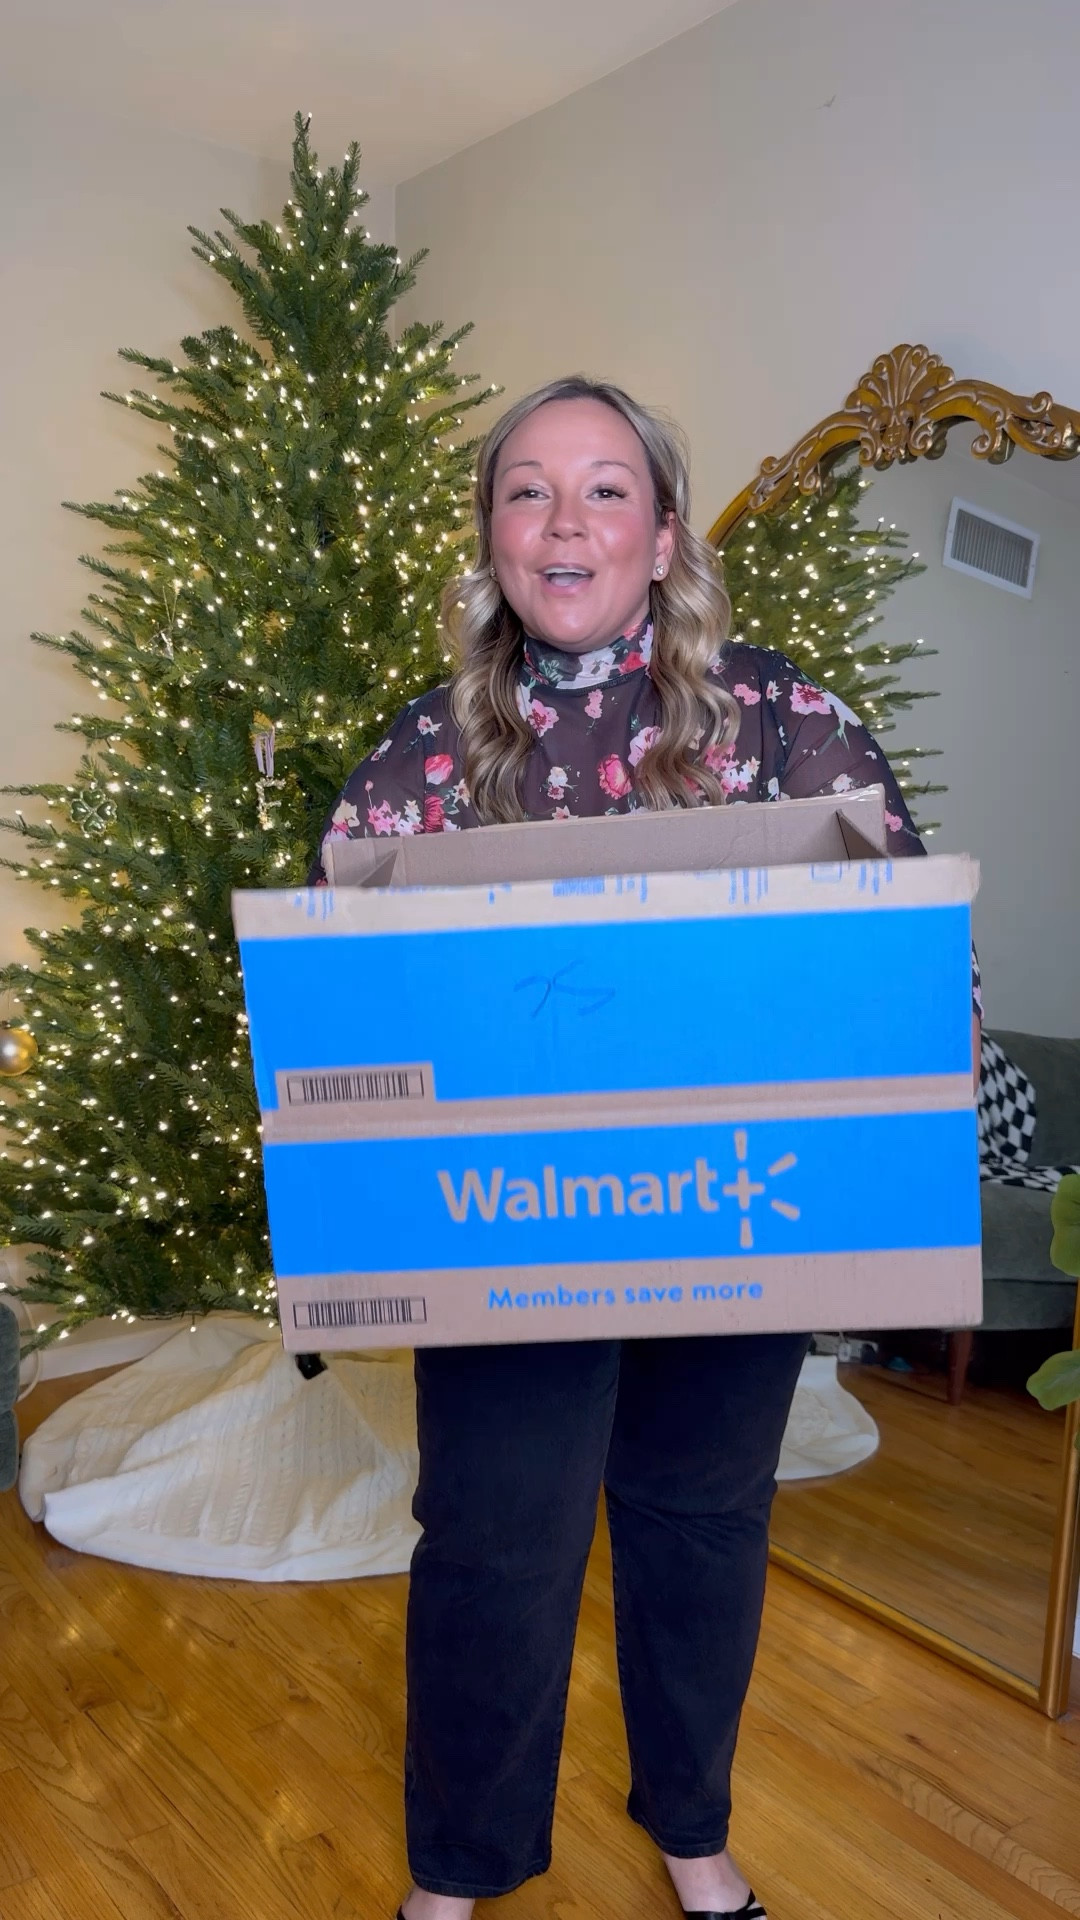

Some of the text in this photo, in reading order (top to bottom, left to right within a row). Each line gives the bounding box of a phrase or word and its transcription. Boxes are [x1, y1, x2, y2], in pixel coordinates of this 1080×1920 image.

[487, 1281, 764, 1309] Members save more
